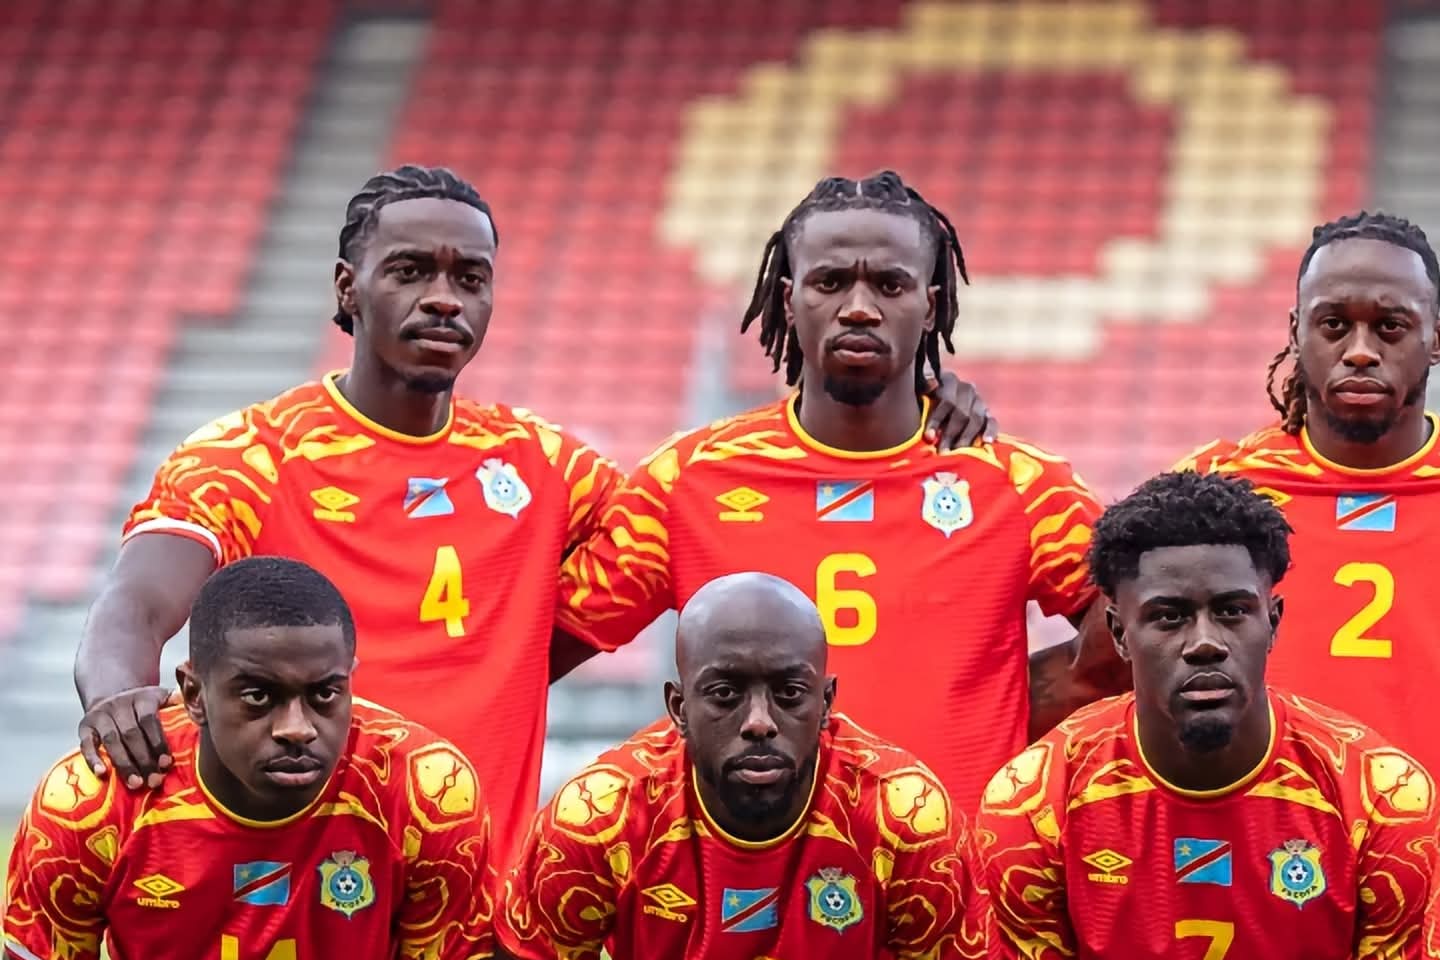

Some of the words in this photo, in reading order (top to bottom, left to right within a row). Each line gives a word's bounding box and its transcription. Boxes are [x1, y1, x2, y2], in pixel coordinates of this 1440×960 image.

[419, 545, 470, 638] 4
[816, 553, 877, 645] 6
[1330, 562, 1395, 658] 2
[137, 897, 181, 909] umbro
